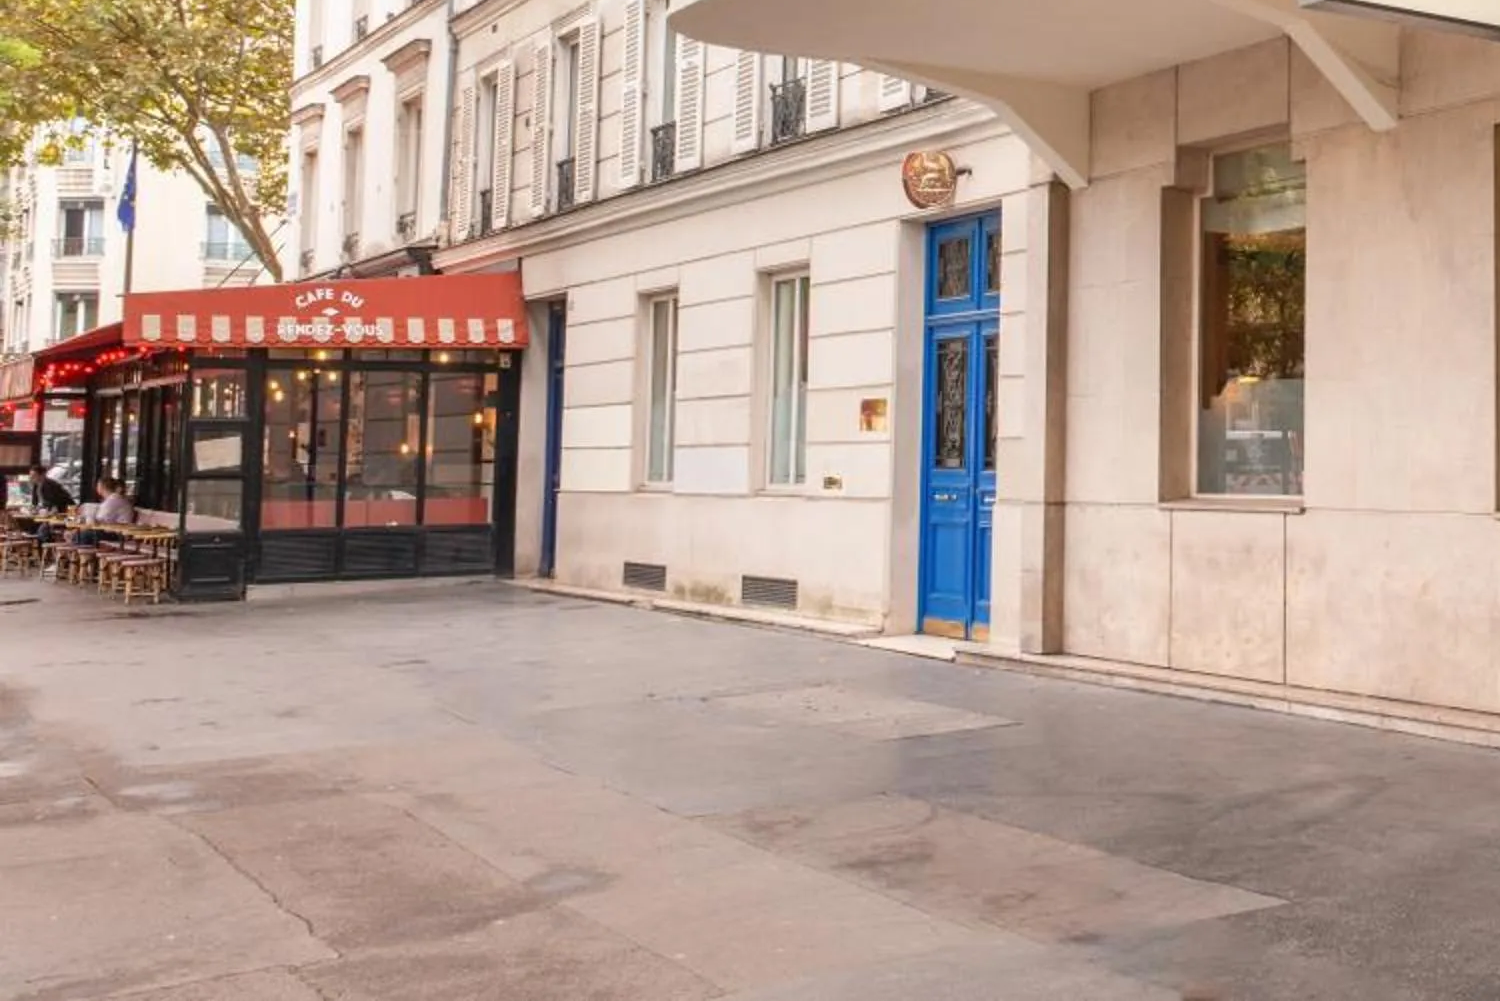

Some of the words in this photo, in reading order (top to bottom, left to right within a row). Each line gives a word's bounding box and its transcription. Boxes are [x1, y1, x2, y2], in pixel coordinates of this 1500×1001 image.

[295, 288, 335, 309] CAFE
[341, 290, 364, 309] DU
[277, 324, 383, 337] RENDEZ-VOUS
